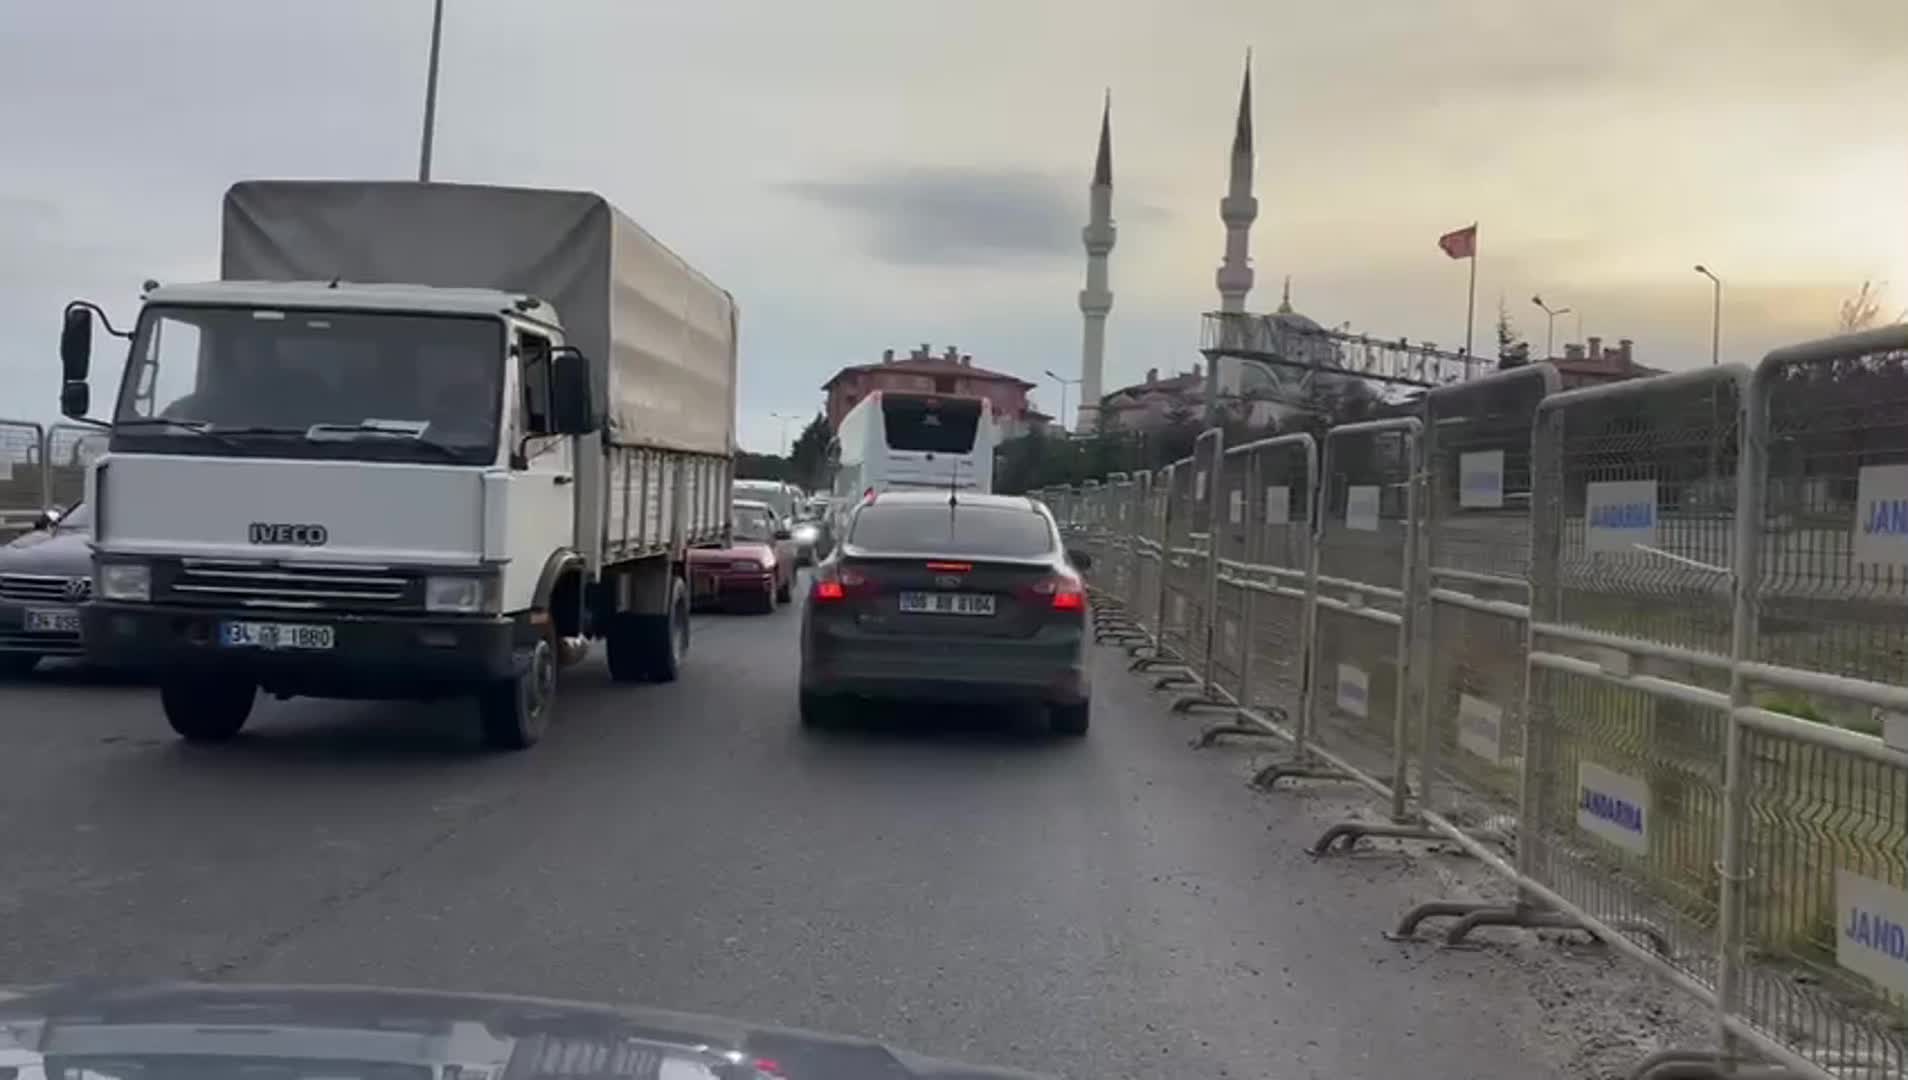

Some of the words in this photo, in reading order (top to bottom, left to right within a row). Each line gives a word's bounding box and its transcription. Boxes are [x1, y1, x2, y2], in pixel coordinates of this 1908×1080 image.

[248, 523, 328, 546] IVECO
[231, 624, 251, 643] 34
[292, 627, 330, 648] 1880
[1845, 906, 1908, 963] JAND
